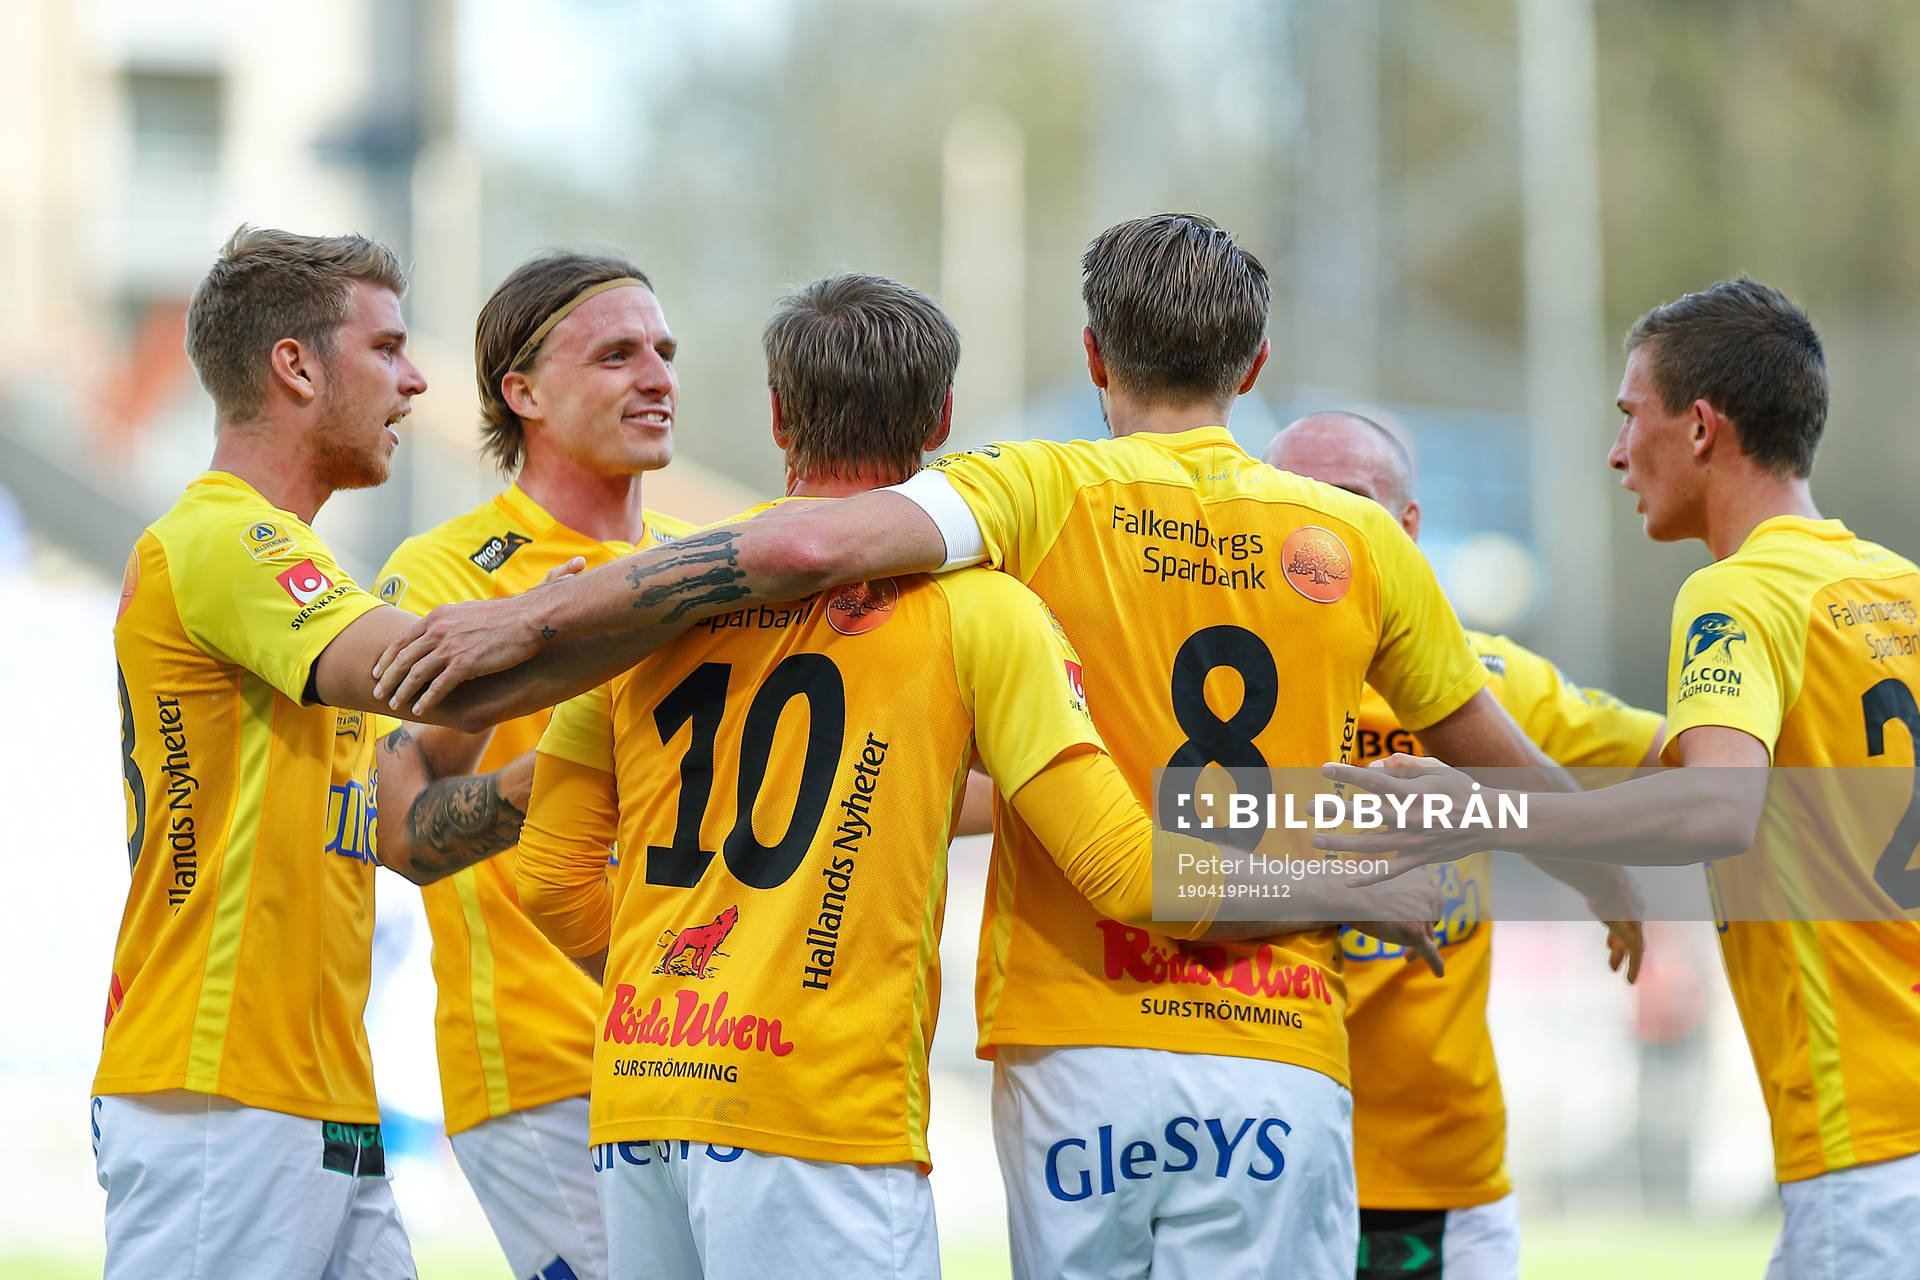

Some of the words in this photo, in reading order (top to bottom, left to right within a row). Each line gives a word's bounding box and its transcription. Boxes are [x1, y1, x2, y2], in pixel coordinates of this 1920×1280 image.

[1143, 546, 1266, 589] Sparbank
[291, 594, 336, 631] SVENSKA
[1679, 667, 1742, 685] ALCON
[1865, 628, 1920, 664] Sparban
[158, 696, 199, 811] Nyheter
[646, 653, 846, 890] 10
[1157, 624, 1279, 856] 8
[168, 816, 198, 917] llands
[802, 856, 855, 990] Hallands
[832, 731, 889, 853] Nyheter
[604, 983, 670, 1046] Röda
[1140, 998, 1303, 1029] SURSTRÖMMING
[613, 1058, 738, 1083] SURSTRÖMMING
[1044, 1116, 1292, 1202] GleSYS
